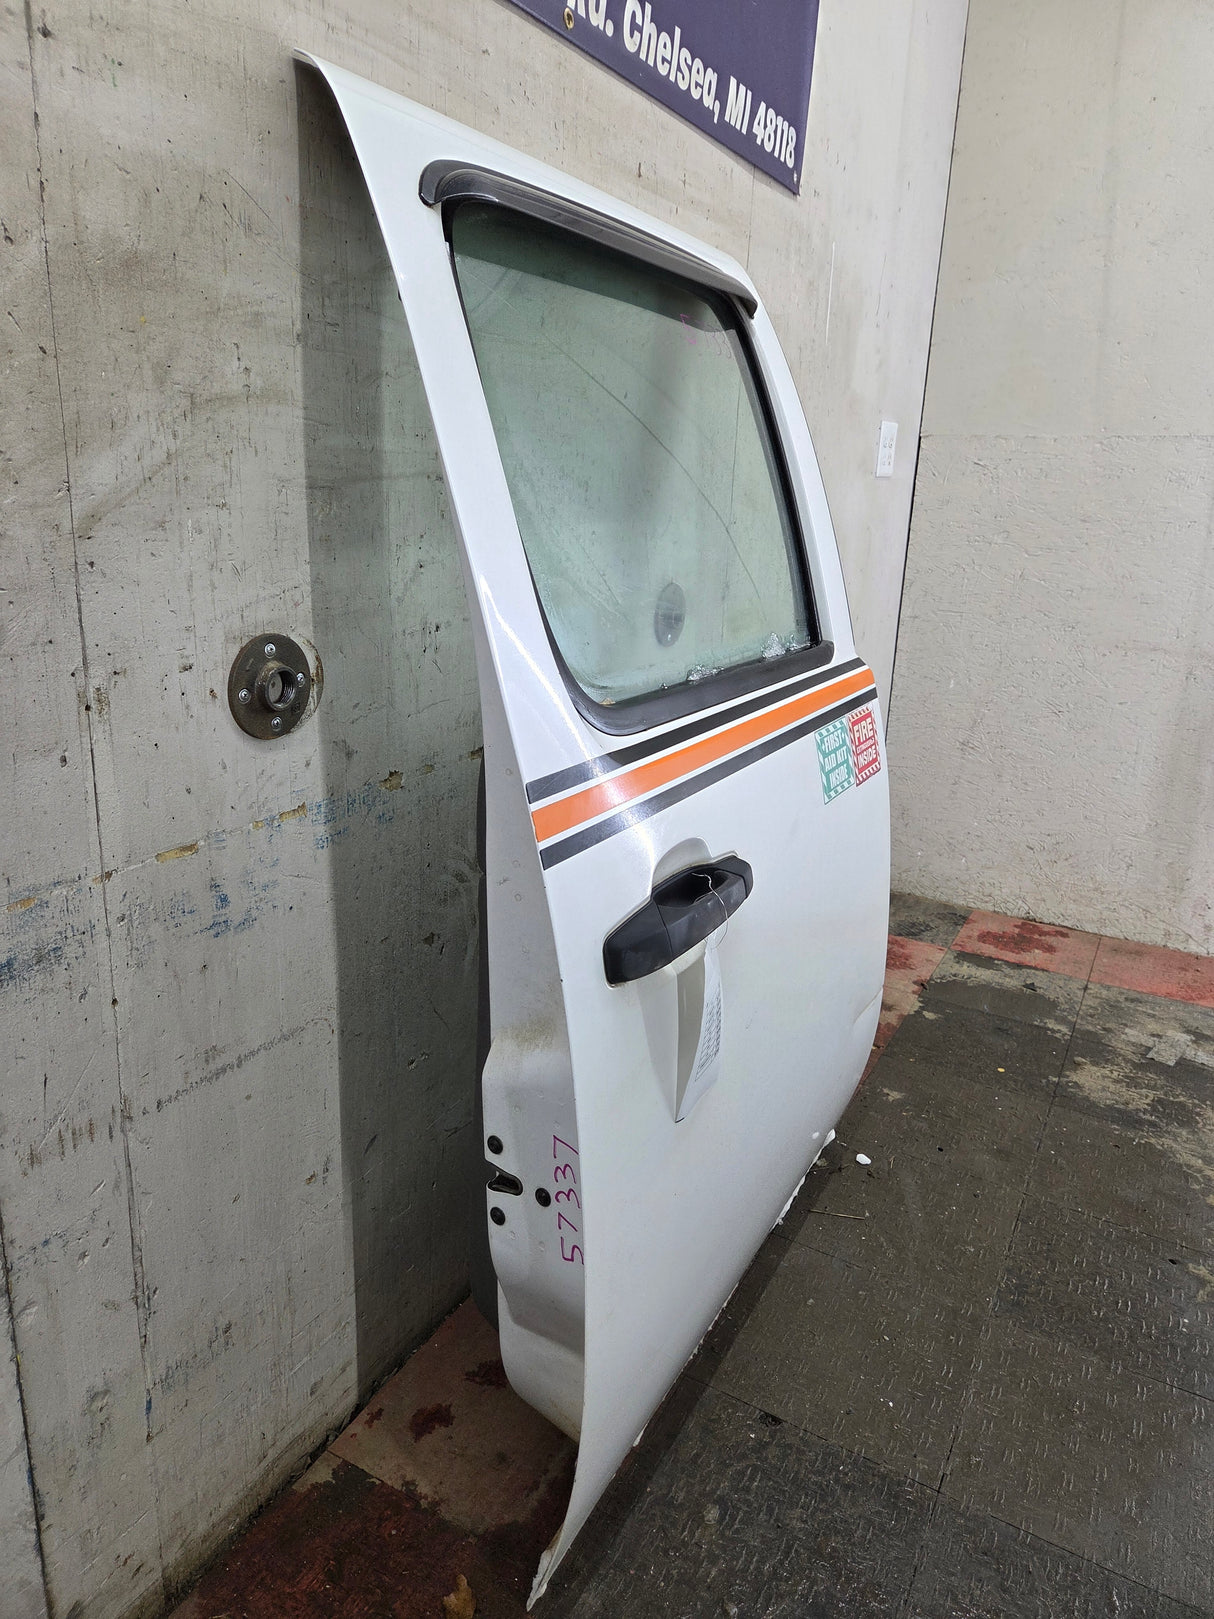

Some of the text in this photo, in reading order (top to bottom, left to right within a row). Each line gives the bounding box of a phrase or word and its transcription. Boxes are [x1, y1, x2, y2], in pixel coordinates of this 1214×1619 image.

[623, 0, 720, 123] Chelsea,
[724, 75, 752, 135] MI
[753, 101, 796, 168] 48118
[823, 729, 843, 753] FIRST
[853, 717, 874, 746] FIRE
[824, 746, 848, 772] AID KIT
[857, 745, 877, 769] INSIDE
[829, 763, 849, 789] INSIDE
[553, 1134, 584, 1265] 57337
